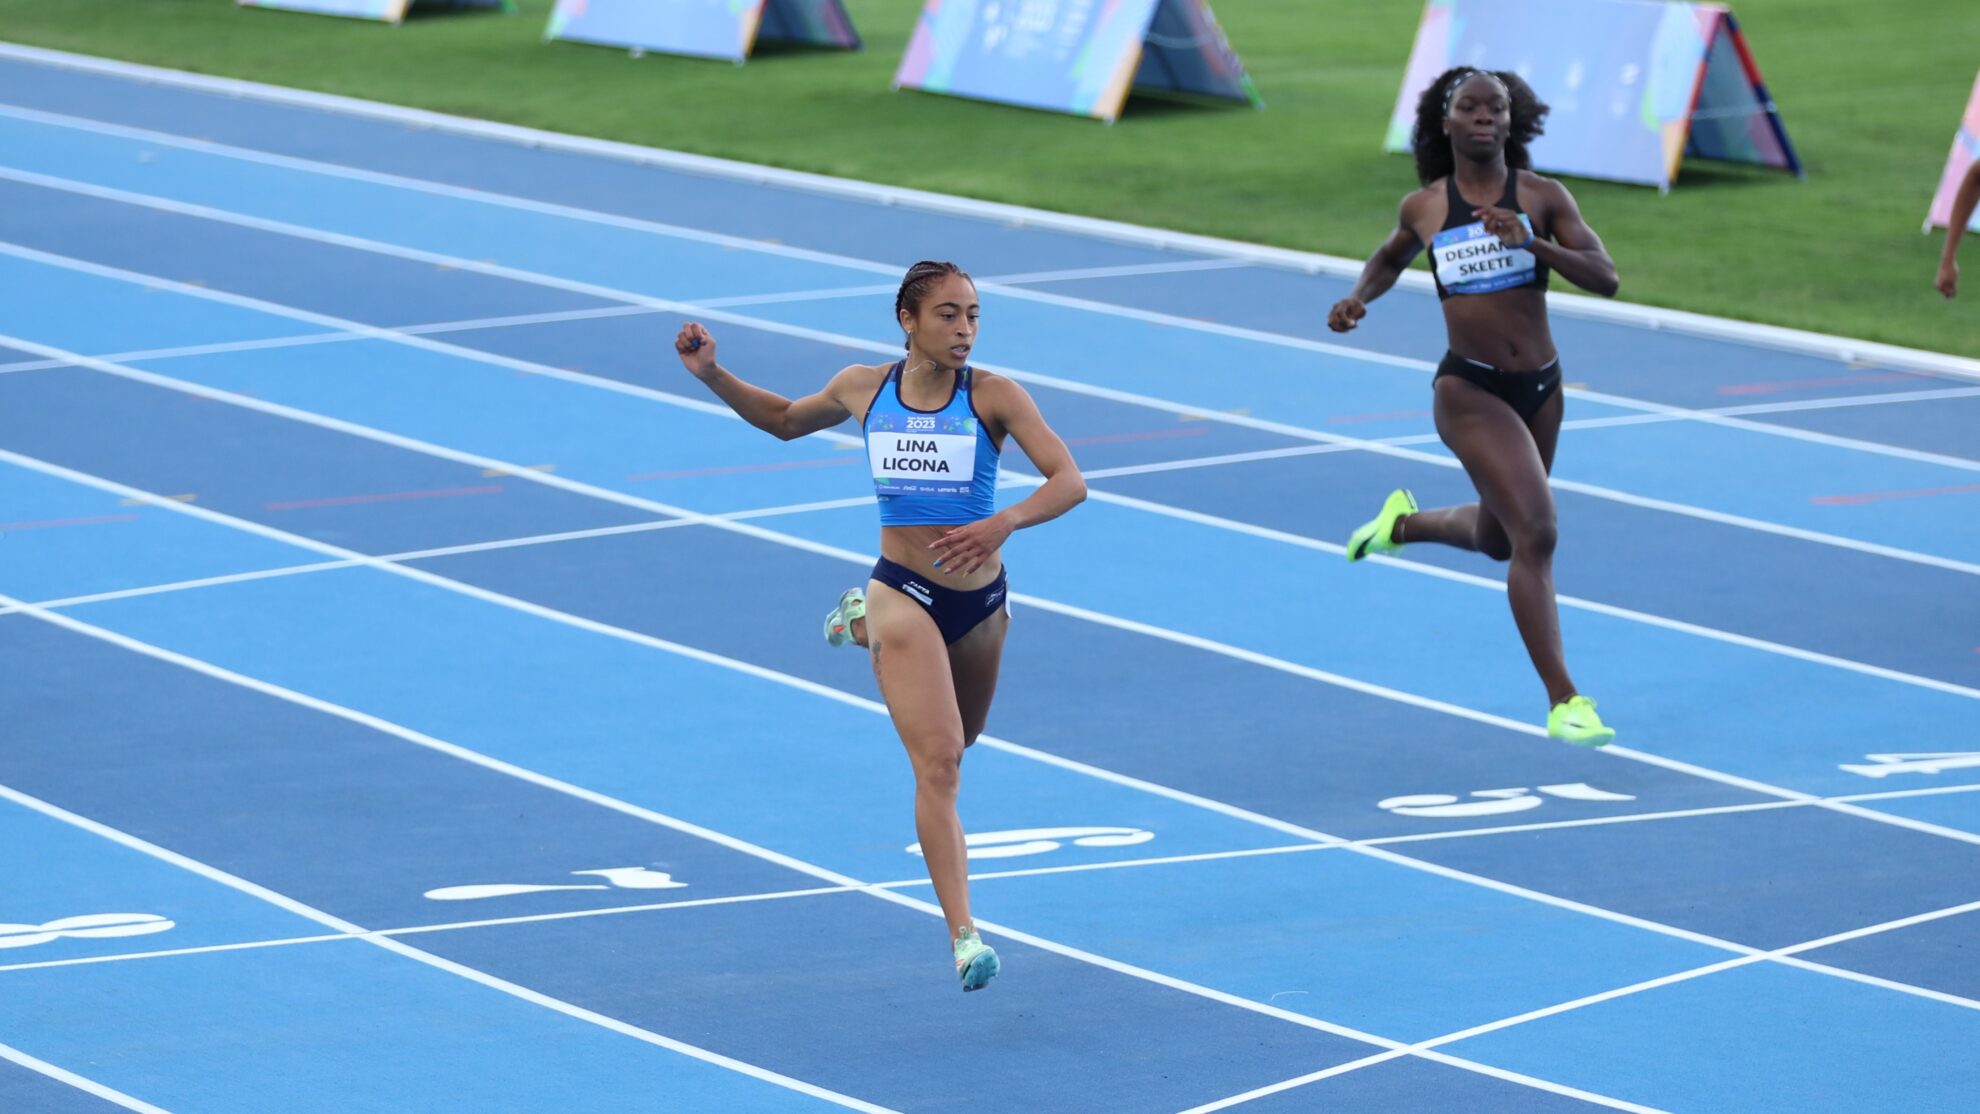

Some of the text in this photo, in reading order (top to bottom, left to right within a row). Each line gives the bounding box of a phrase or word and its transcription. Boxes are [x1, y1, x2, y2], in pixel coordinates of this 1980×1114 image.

[1459, 255, 1514, 277] SKEETE
[906, 419, 936, 429] 2023
[896, 439, 938, 453] LINA
[882, 457, 950, 473] LICONA
[1378, 783, 1637, 817] 5
[905, 827, 1155, 859] 6
[424, 866, 689, 900] 7
[0, 913, 176, 949] 8
